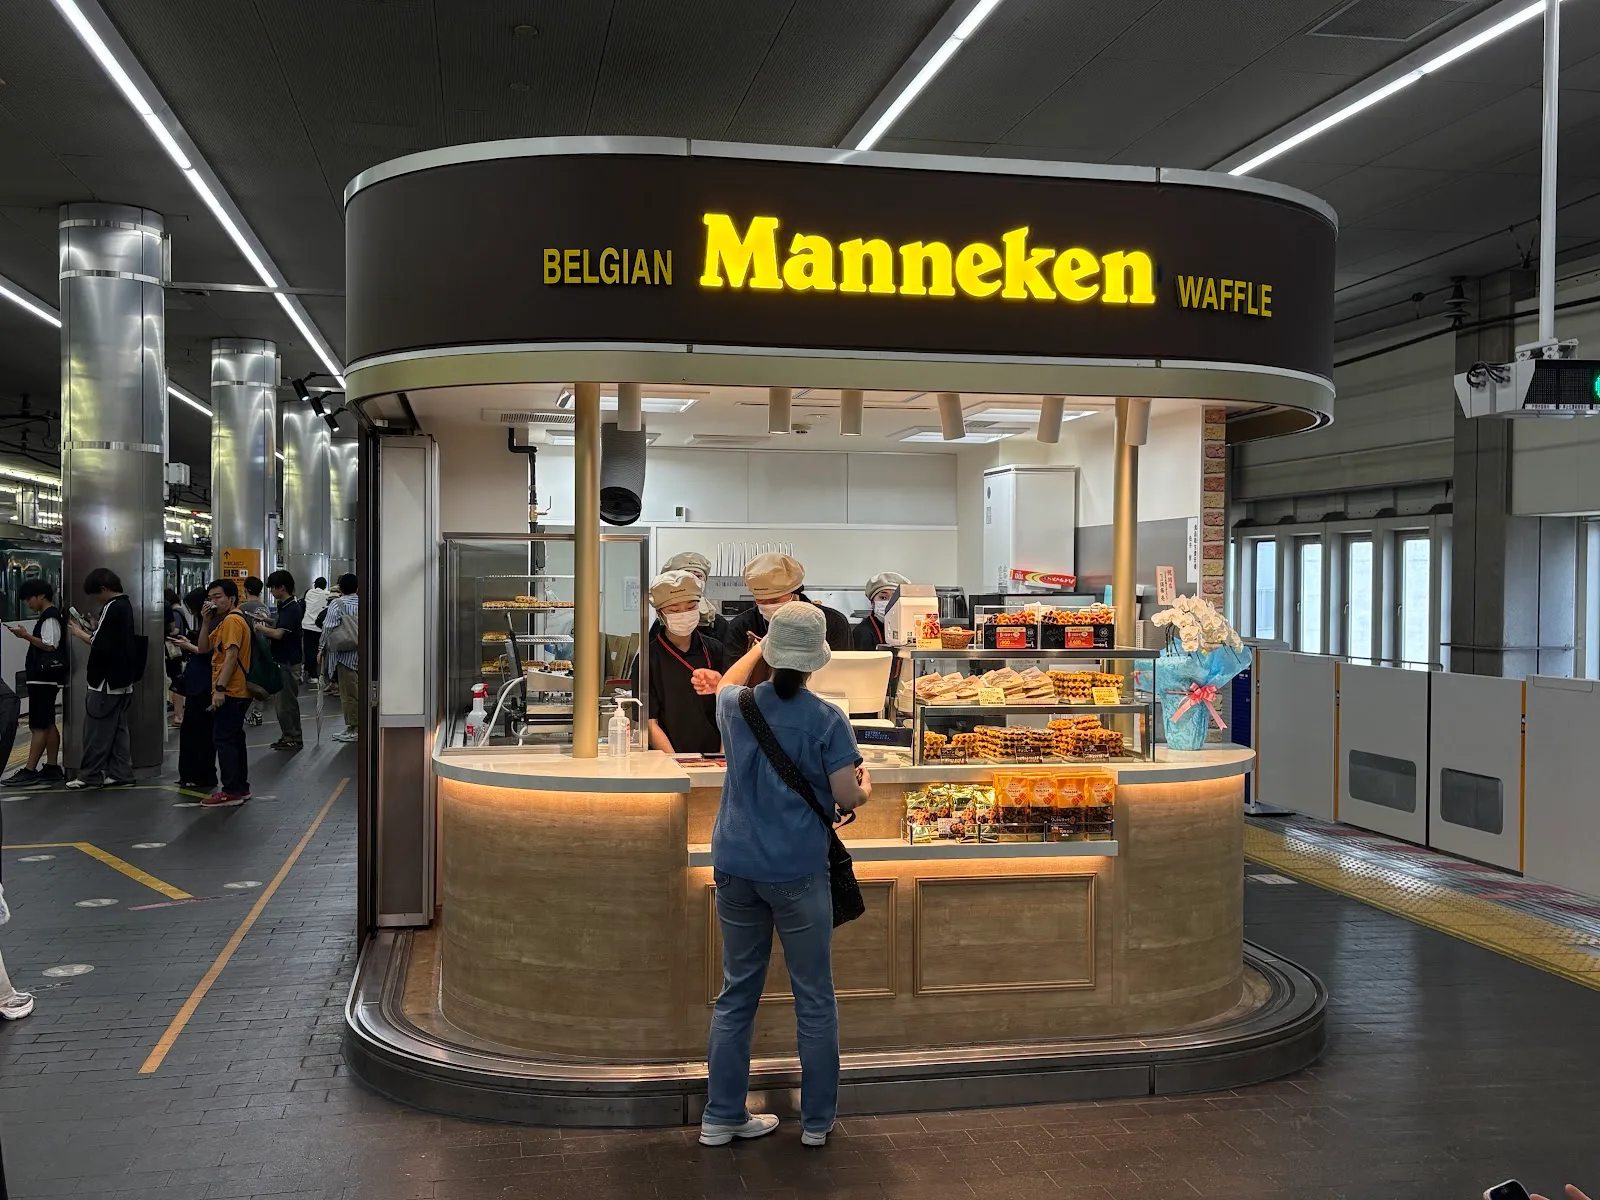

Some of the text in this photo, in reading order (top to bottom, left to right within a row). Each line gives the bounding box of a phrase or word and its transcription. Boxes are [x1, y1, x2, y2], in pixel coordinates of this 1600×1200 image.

[543, 212, 1274, 318] BELGIAN Manneken WAFFLE
